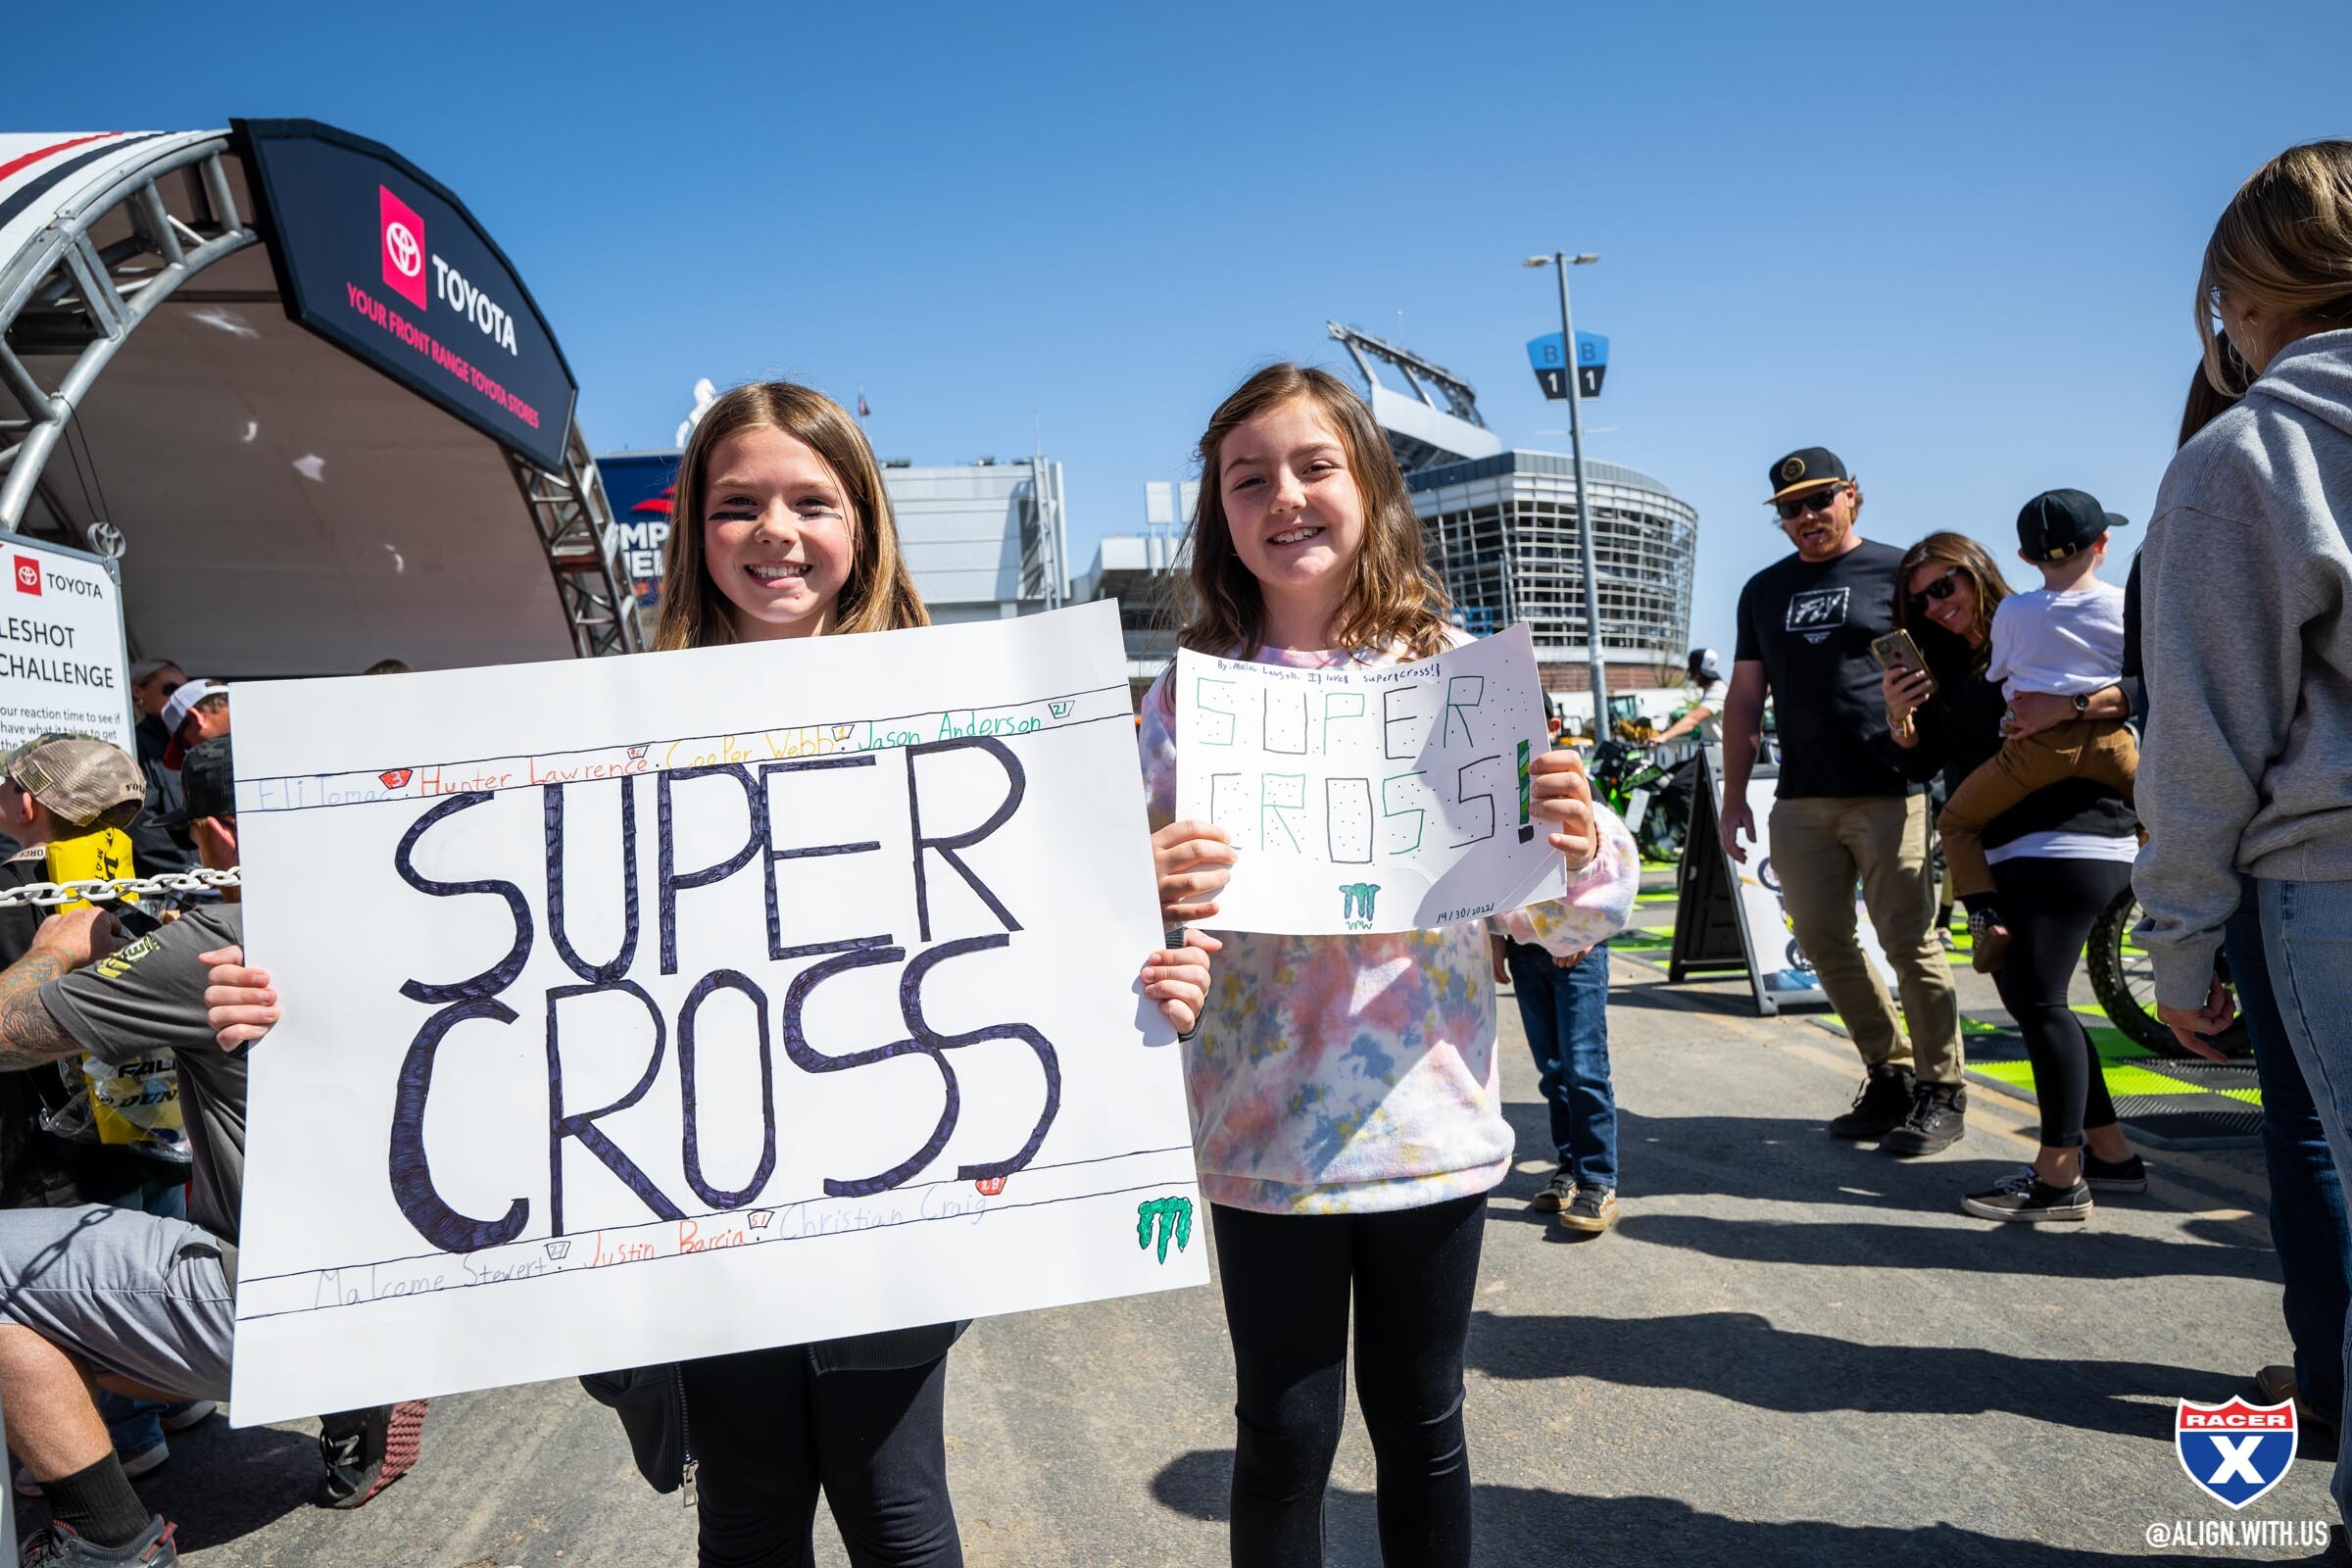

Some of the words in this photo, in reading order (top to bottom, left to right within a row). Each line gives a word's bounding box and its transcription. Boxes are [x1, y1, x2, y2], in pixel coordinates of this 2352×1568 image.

[432, 254, 517, 357] TOYOTA
[347, 282, 387, 329] YOUR
[389, 312, 430, 356] FRONT
[431, 339, 469, 383] RANGE
[470, 367, 507, 408] TOYOTA
[508, 393, 539, 429] STORES
[1544, 345, 1558, 364] B
[1581, 343, 1595, 362] B
[1547, 372, 1557, 392] 1
[1586, 370, 1594, 390] 1
[47, 573, 103, 599] TOYOTA
[0, 654, 115, 688] CHALLENGE
[21, 708, 61, 719] reaction
[64, 710, 84, 721] time
[87, 712, 96, 722] to
[98, 714, 113, 723] see
[115, 713, 121, 724] if
[1198, 675, 1484, 759] SUPER
[0, 721, 25, 735] have
[27, 723, 52, 734] what
[102, 730, 117, 740] get
[259, 777, 304, 810] Eli
[316, 774, 393, 807] Tomac
[420, 765, 513, 796] Hunter
[530, 756, 648, 785] Lawrence
[765, 725, 834, 759] Webb
[858, 720, 920, 751] Jason
[939, 710, 1043, 741] Anderson
[1053, 702, 1067, 715] 21
[395, 735, 1025, 1004] SUPER
[118, 1057, 176, 1079] FAL
[119, 1090, 178, 1107] DUN
[389, 934, 1061, 1253] CROSS
[583, 1230, 656, 1268] Justin
[680, 1219, 746, 1254] Barcia
[752, 1213, 765, 1226] 51
[780, 1202, 903, 1240] Christian
[920, 1183, 989, 1225] Craig
[982, 1177, 999, 1191] 28
